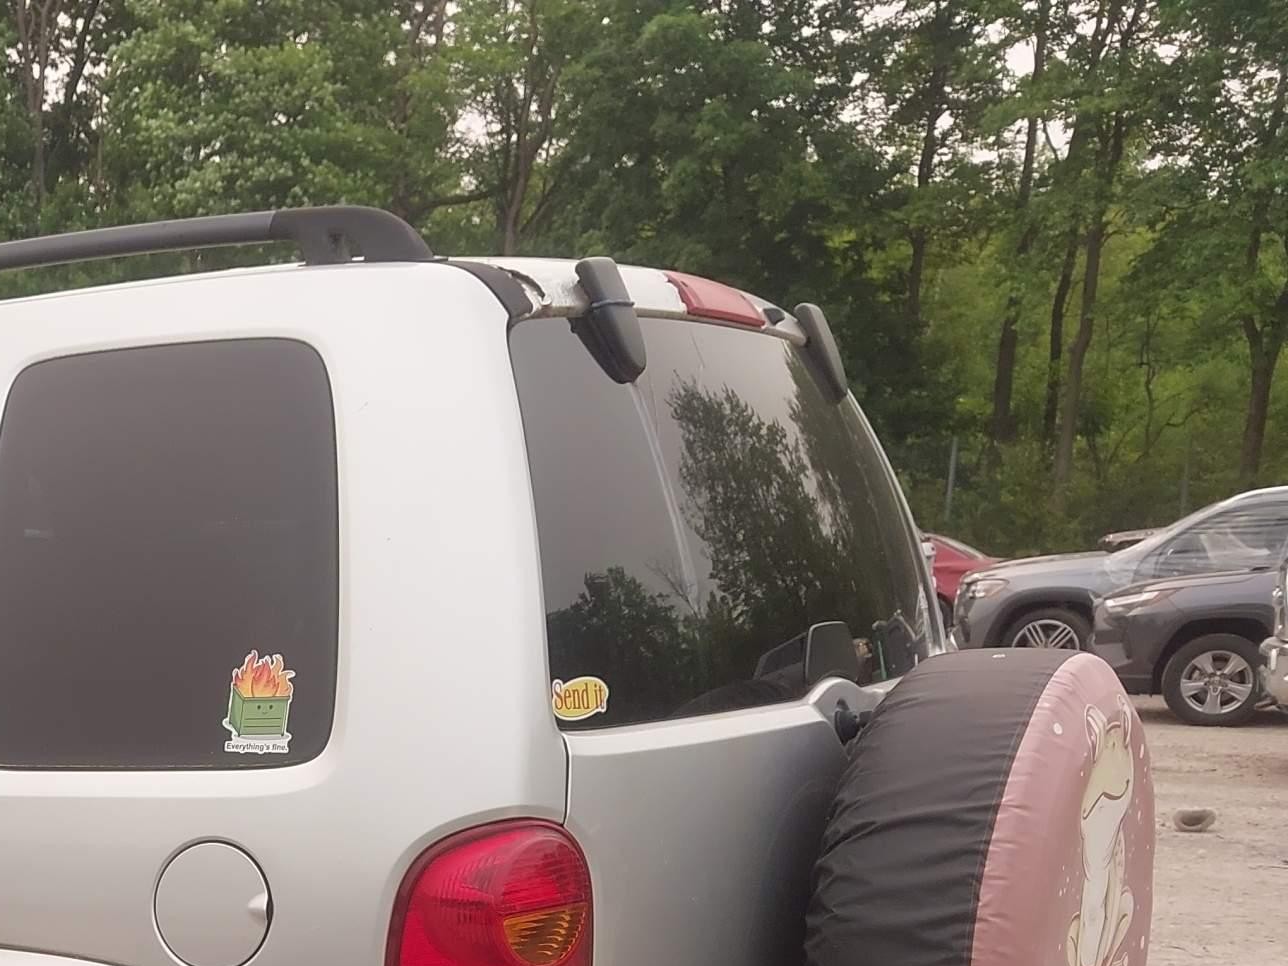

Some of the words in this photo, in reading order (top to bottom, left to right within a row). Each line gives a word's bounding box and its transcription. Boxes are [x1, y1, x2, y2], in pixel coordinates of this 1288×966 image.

[553, 681, 590, 711] Send
[593, 682, 605, 711] it
[226, 742, 271, 752] Everything's
